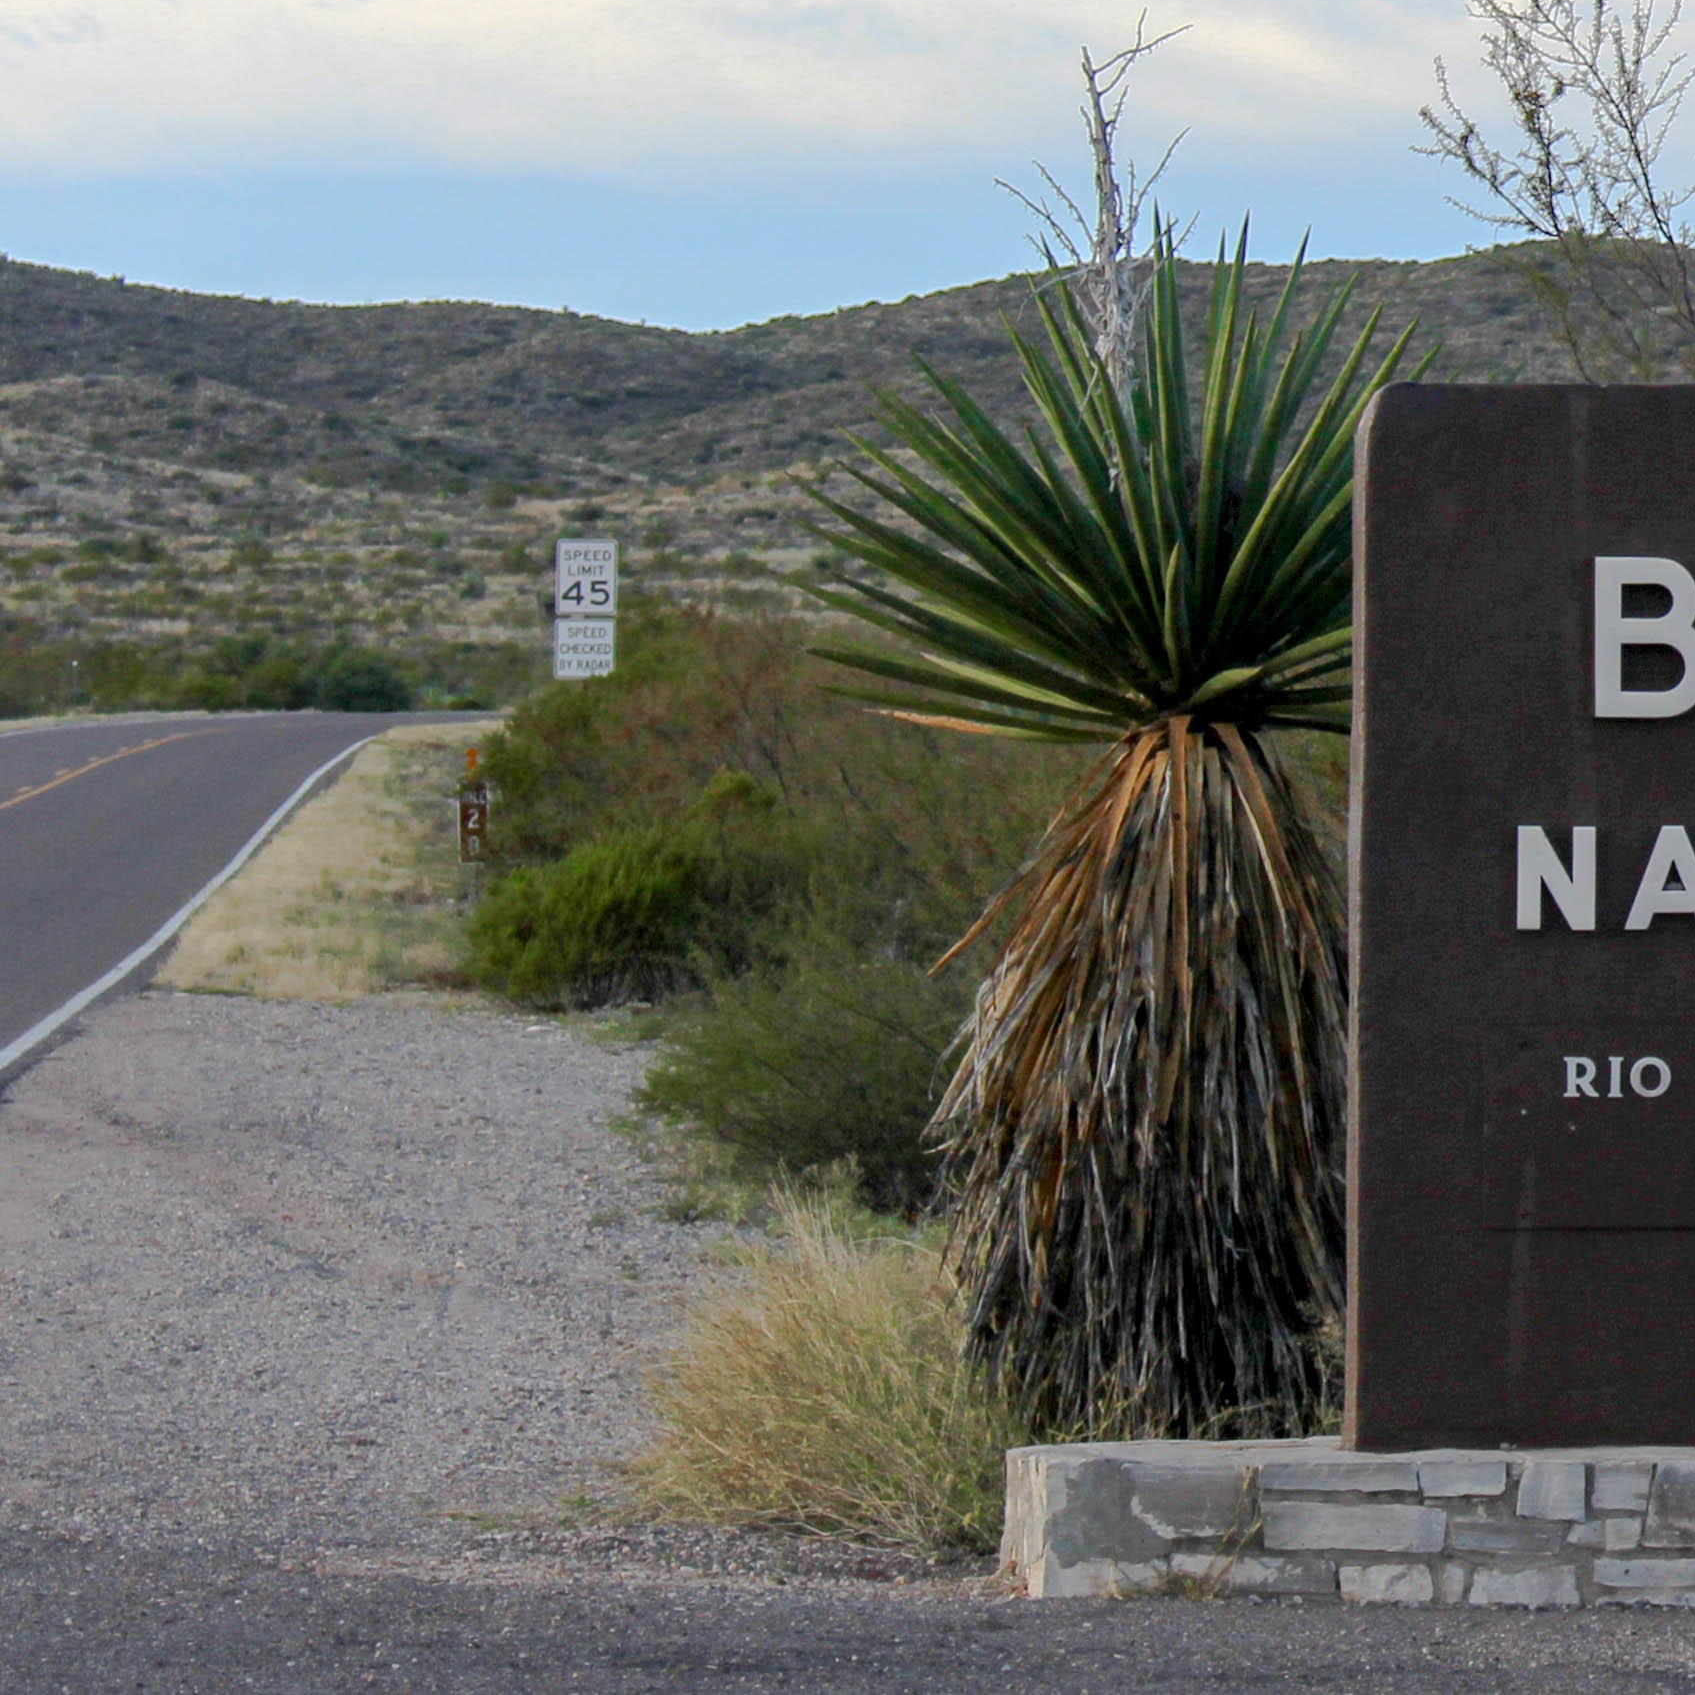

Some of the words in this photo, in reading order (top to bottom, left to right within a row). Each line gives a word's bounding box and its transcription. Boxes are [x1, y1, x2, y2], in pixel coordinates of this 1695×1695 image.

[563, 549, 612, 562] SPEED
[567, 565, 605, 577] LIMIT
[561, 580, 610, 606] 45
[567, 627, 607, 639] SPEED
[559, 643, 612, 655] CHECKED
[559, 659, 573, 671] BY
[576, 659, 611, 671] RADAR
[1562, 1055, 1673, 1099] RIO
